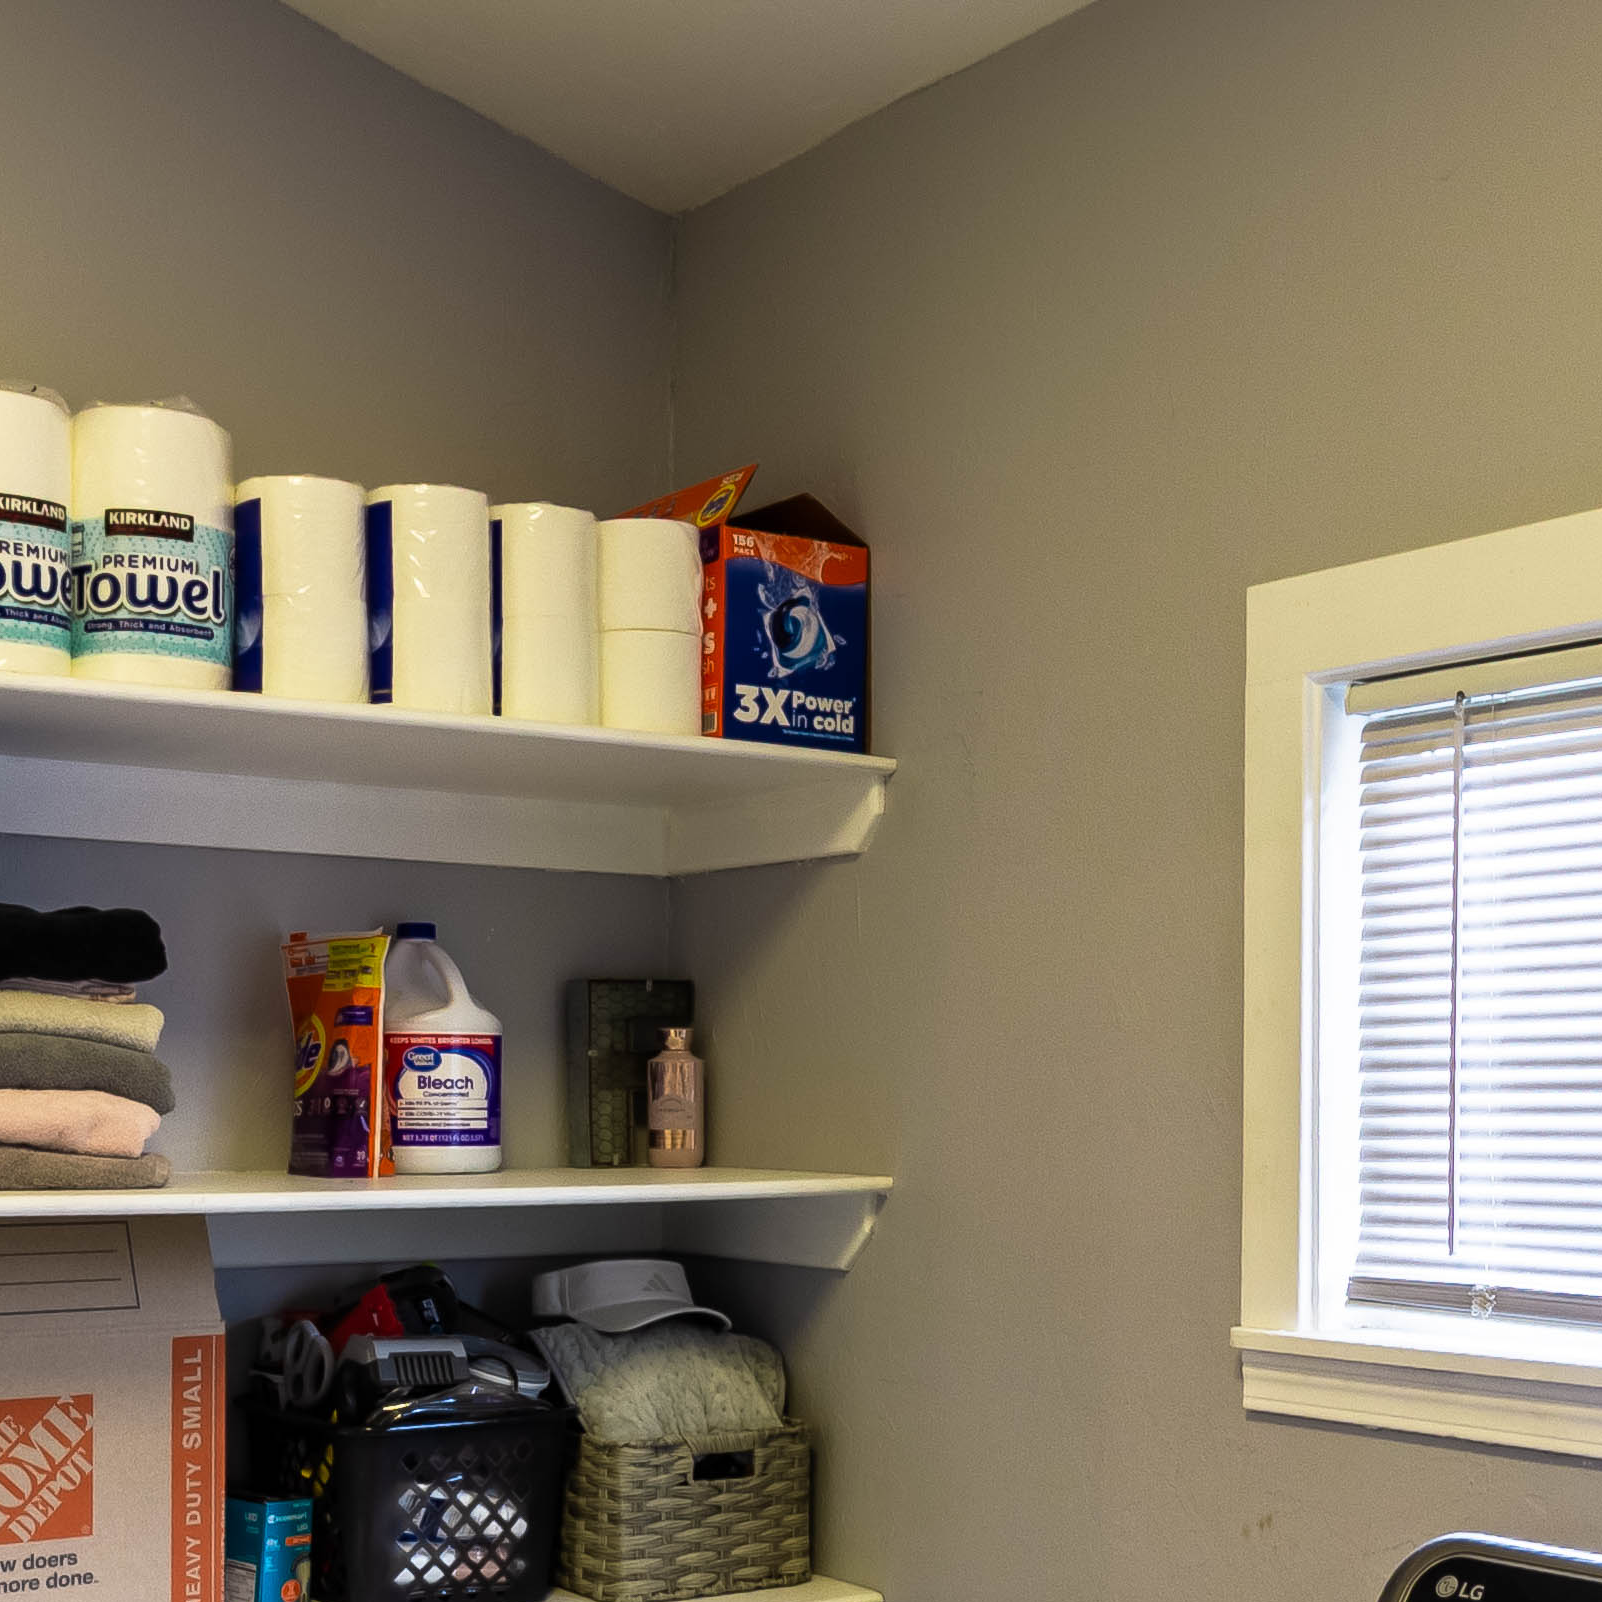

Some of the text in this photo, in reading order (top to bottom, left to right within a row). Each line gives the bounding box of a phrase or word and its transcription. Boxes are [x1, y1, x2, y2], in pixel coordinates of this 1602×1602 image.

[109, 512, 191, 531] KIRKLAND
[102, 554, 195, 576] PREMIUM
[72, 564, 224, 620] Towel
[5, 607, 30, 618] Thick
[119, 620, 145, 630] Thick
[148, 623, 166, 632] and
[169, 625, 213, 638] Absorbent
[733, 684, 791, 727] 3X
[792, 709, 855, 734] in cold
[408, 1052, 434, 1062] Great
[417, 1075, 474, 1090] Bleach
[182, 1348, 202, 1450] SMALL
[7, 1447, 94, 1543] DEPOT
[185, 1462, 202, 1526] DUTY
[22, 1552, 78, 1571] doers
[1458, 1582, 1485, 1600] LG
